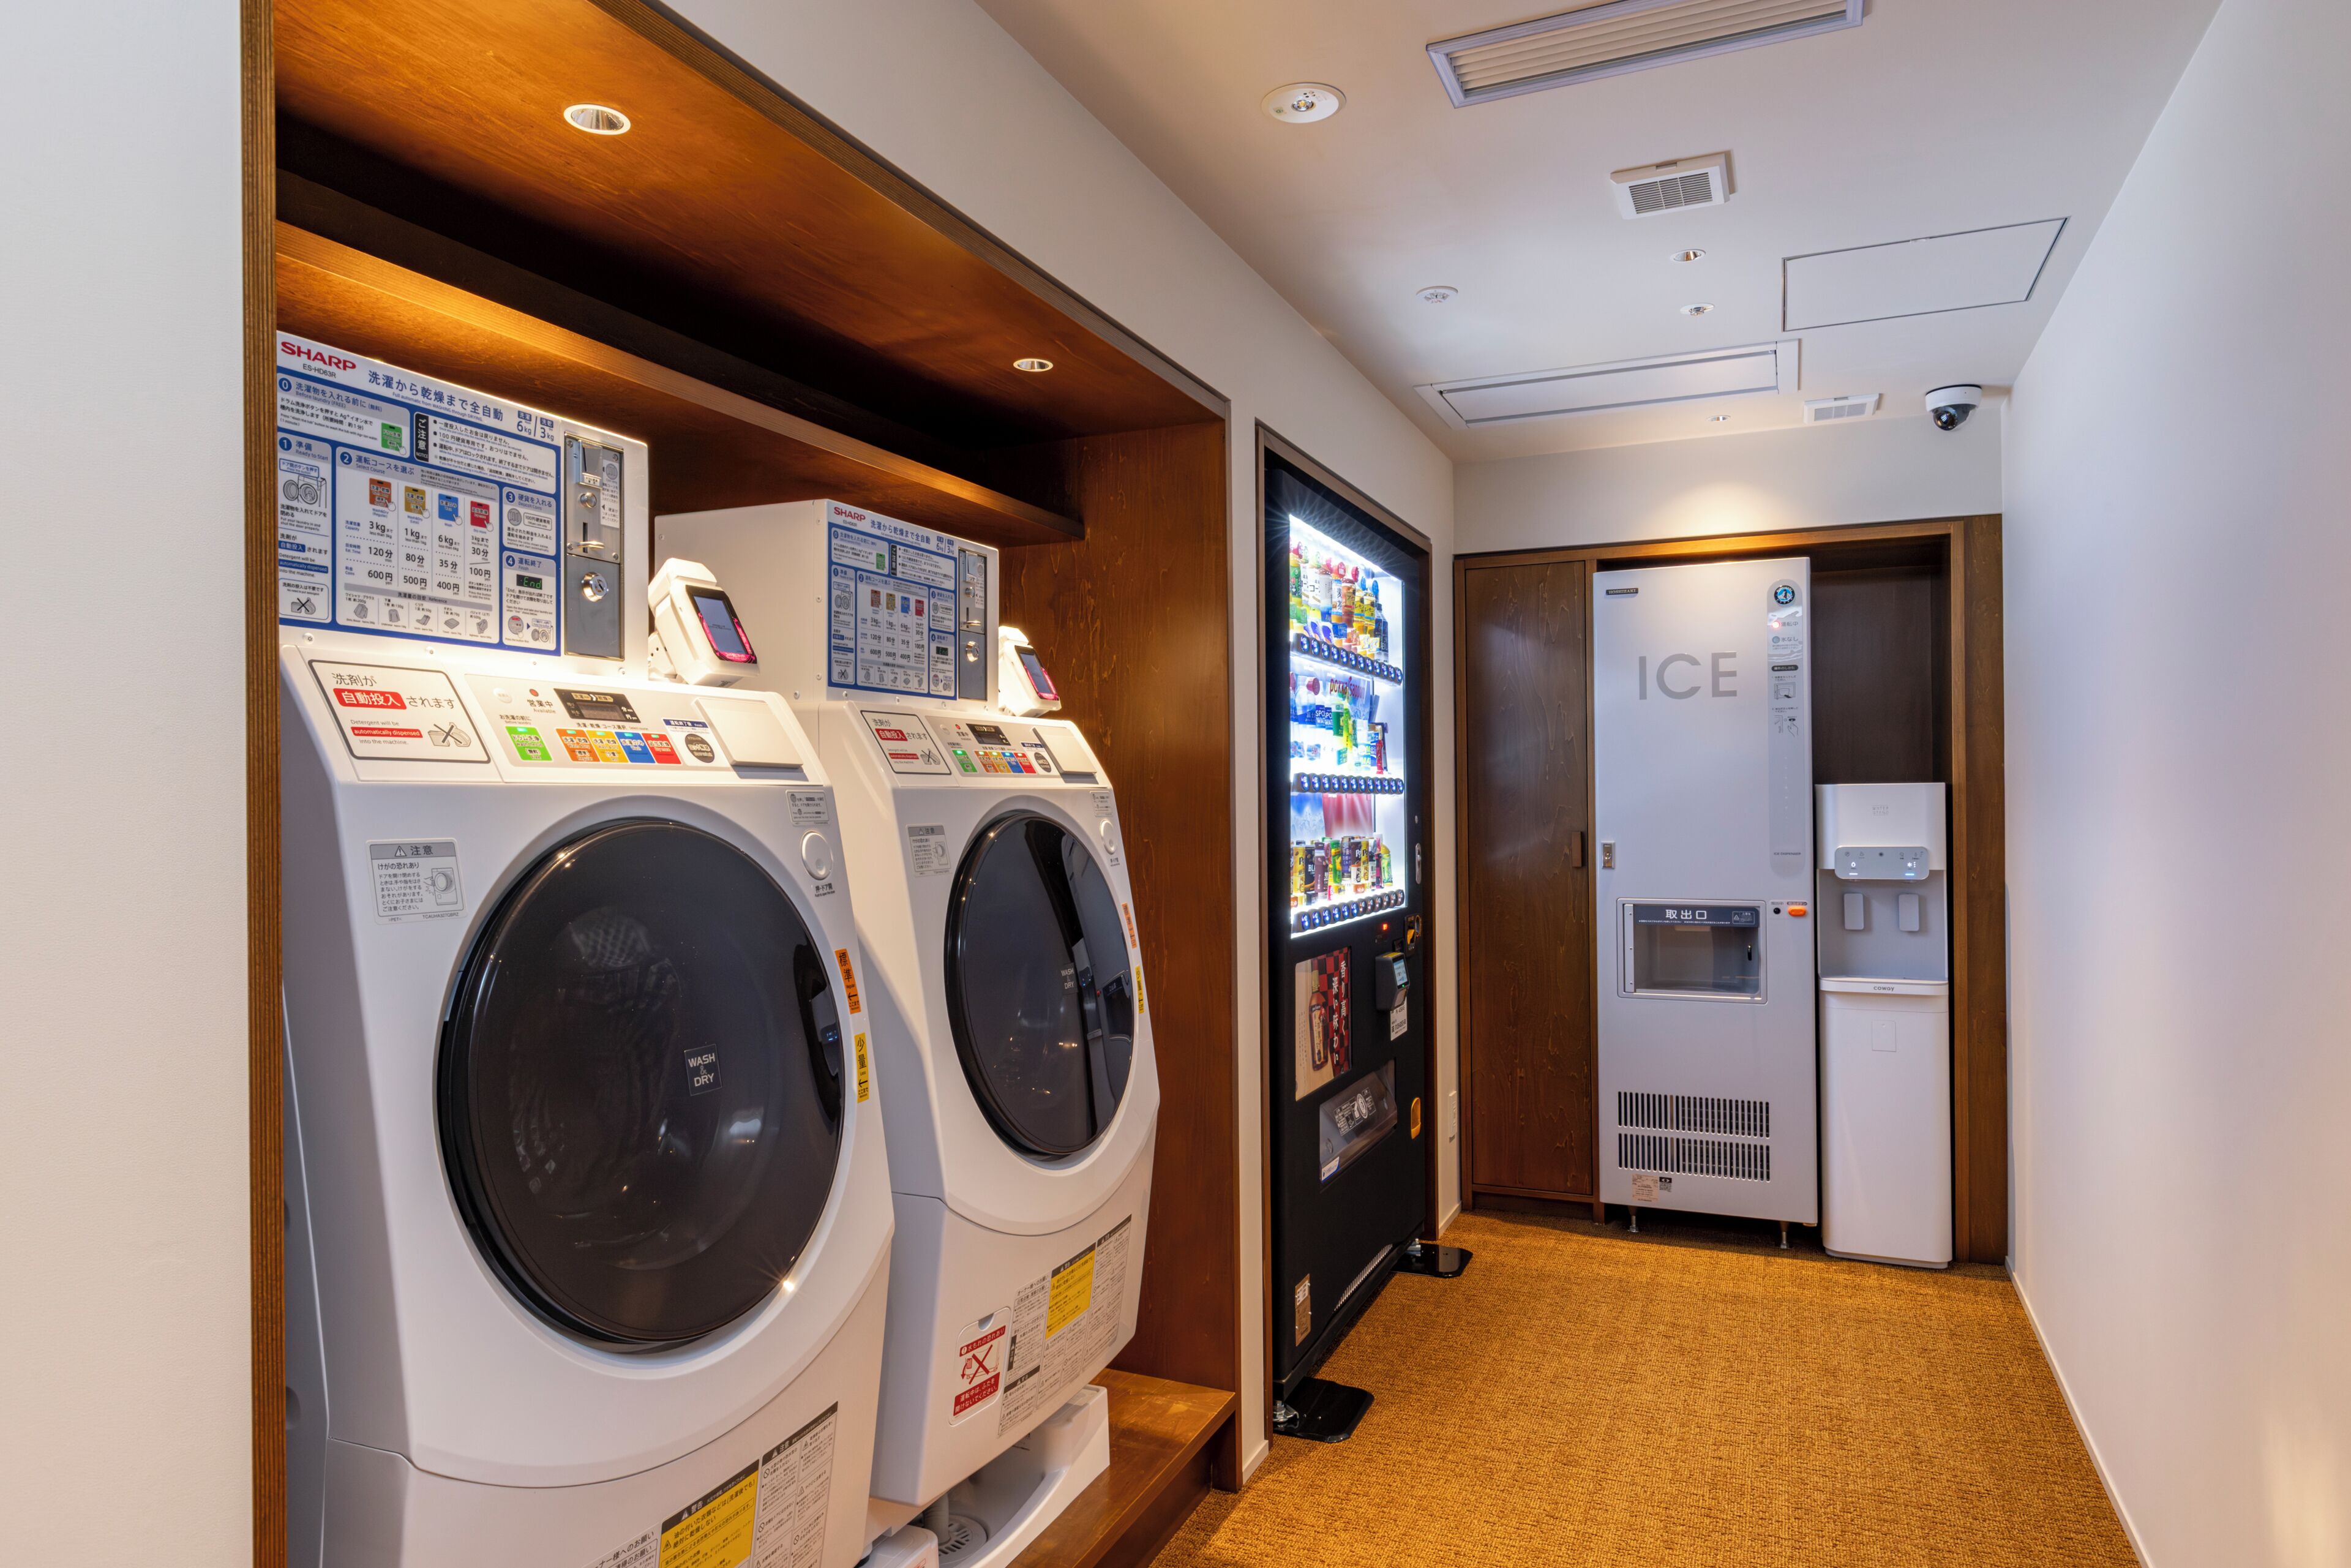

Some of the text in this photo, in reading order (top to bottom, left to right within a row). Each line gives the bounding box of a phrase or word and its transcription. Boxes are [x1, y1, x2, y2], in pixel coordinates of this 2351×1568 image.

[281, 341, 356, 371] SHARP
[302, 362, 336, 378] ES-HD63R
[295, 381, 366, 408] 洗濯物を入れる前に
[296, 391, 311, 400] Before
[312, 395, 329, 405] laundry
[368, 369, 503, 421] 洗濯から乾燥まで全自動
[417, 418, 427, 451] ご注意
[296, 440, 312, 451] 準備
[356, 454, 414, 475] 運転コースを選ぶ
[518, 493, 552, 508] 硬貨を入れる
[280, 503, 326, 517] 洗濯物を入れてドアを
[834, 506, 865, 523] SHARP
[507, 527, 552, 539] 表示された料金を入れると
[871, 519, 930, 544] 洗濯から乾燥まで全自動
[280, 541, 328, 555] 自動投入 されます
[368, 546, 392, 559] 120分
[471, 546, 488, 557] 30分
[279, 552, 301, 561] Detergent
[405, 552, 424, 564] 80分
[518, 557, 541, 568] 運転終了
[280, 560, 326, 572] automatically dispensed
[439, 558, 457, 570] 35分
[368, 569, 392, 582] 600円
[470, 566, 490, 578] 100円
[282, 582, 323, 592] 洗剤の投入は不要です
[403, 575, 426, 587] 500円
[437, 580, 459, 592] 400円
[523, 576, 541, 589] End
[397, 591, 426, 601] 洗濯量の目安
[332, 672, 377, 686] 洗剤が
[1639, 651, 1738, 700] ICE
[342, 691, 454, 709] 自動投入 されます
[527, 699, 554, 708] 営業中
[879, 730, 904, 739] 自動投入
[410, 845, 433, 856] 注意
[378, 862, 419, 871] けがの恐れあり
[1665, 909, 1707, 920] 取出口
[839, 952, 852, 982] 標準
[688, 1053, 715, 1067] WASH
[857, 1037, 866, 1070] 少量
[700, 1066, 707, 1075] &
[694, 1073, 714, 1087] DRY
[967, 1327, 1005, 1351] 水もれの恐れあり
[960, 1378, 995, 1402] 運転中は、ふたを
[955, 1386, 997, 1412] 開けないでください。
[673, 1479, 754, 1540] 油の付いた衣類などは(洗濯後でも)
[691, 1499, 703, 1514] 警告
[673, 1515, 715, 1549] 絶対に乾燥しない
[594, 1531, 654, 1568] ナー様へのお願い
